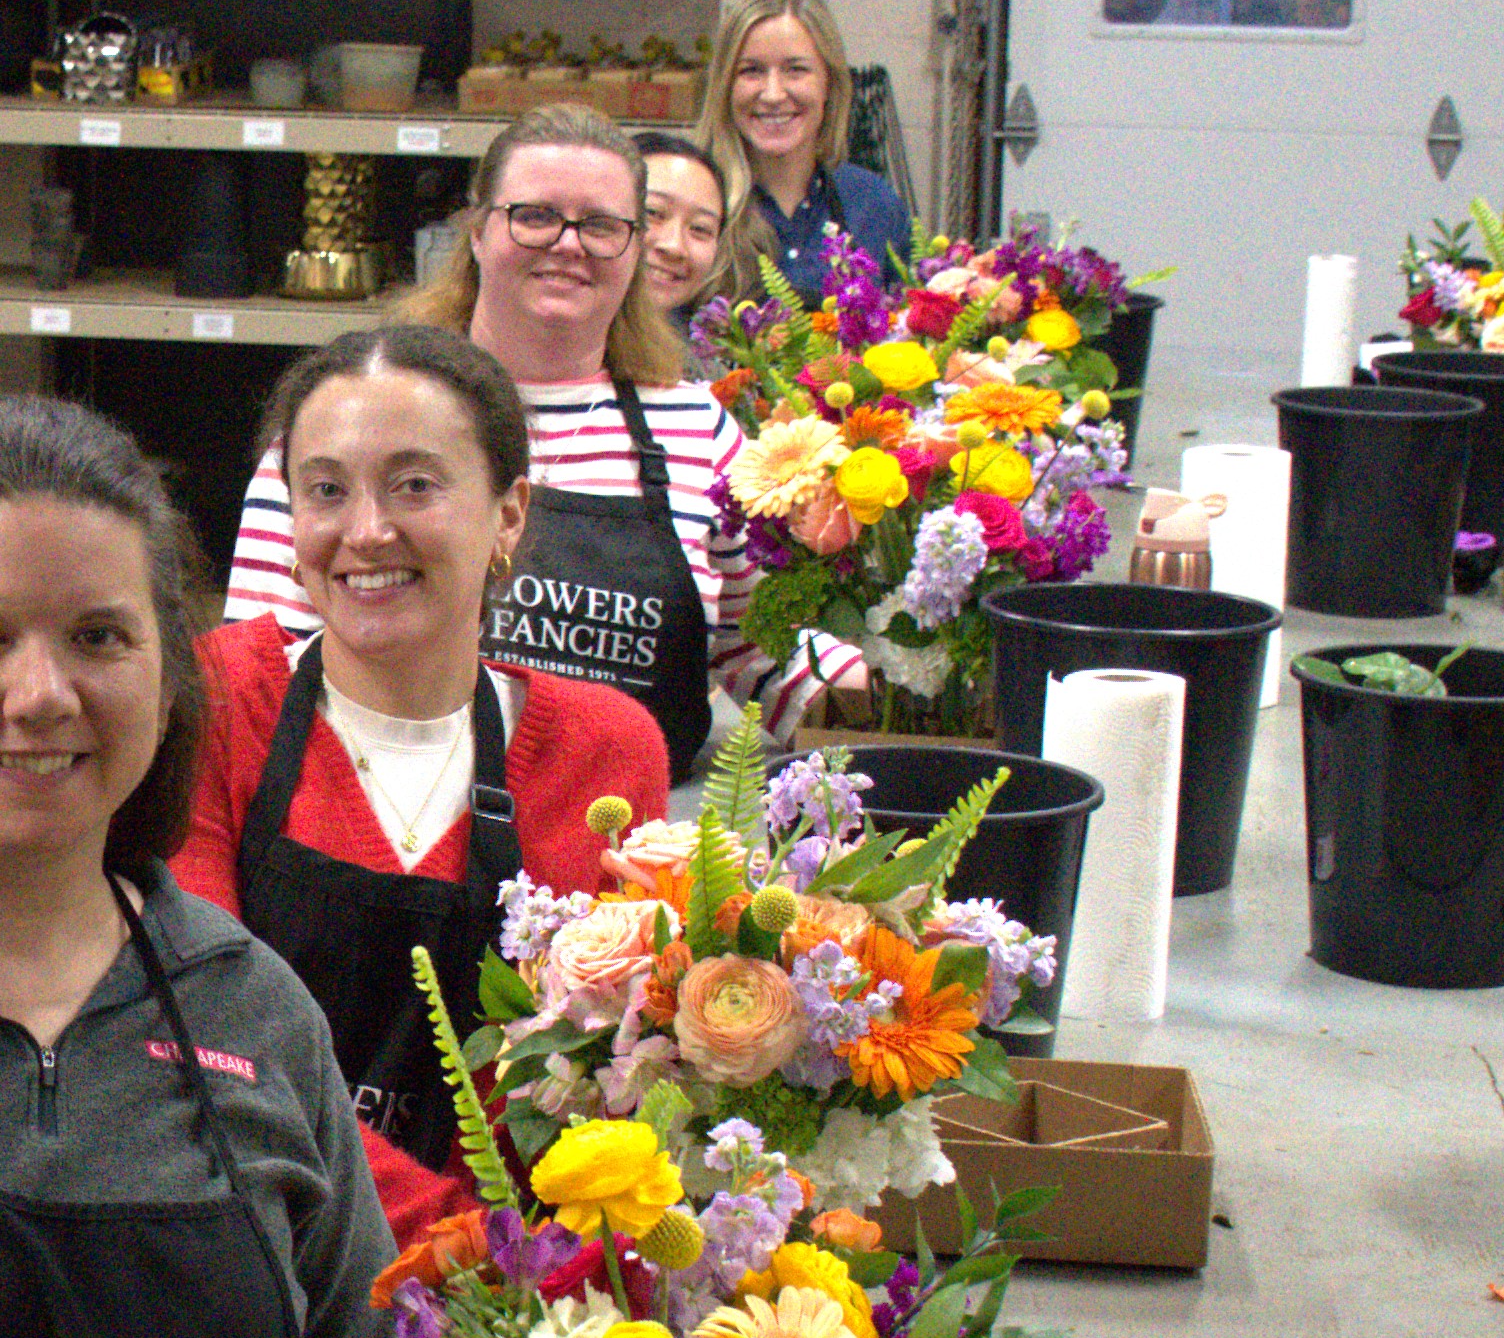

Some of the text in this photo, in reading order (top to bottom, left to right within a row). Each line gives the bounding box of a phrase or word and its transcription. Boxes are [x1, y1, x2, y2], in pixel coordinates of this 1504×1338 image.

[490, 608, 658, 668] FANCIES
[494, 651, 584, 677] ESTABLISHED
[149, 1042, 255, 1079] CHAPEAKE
